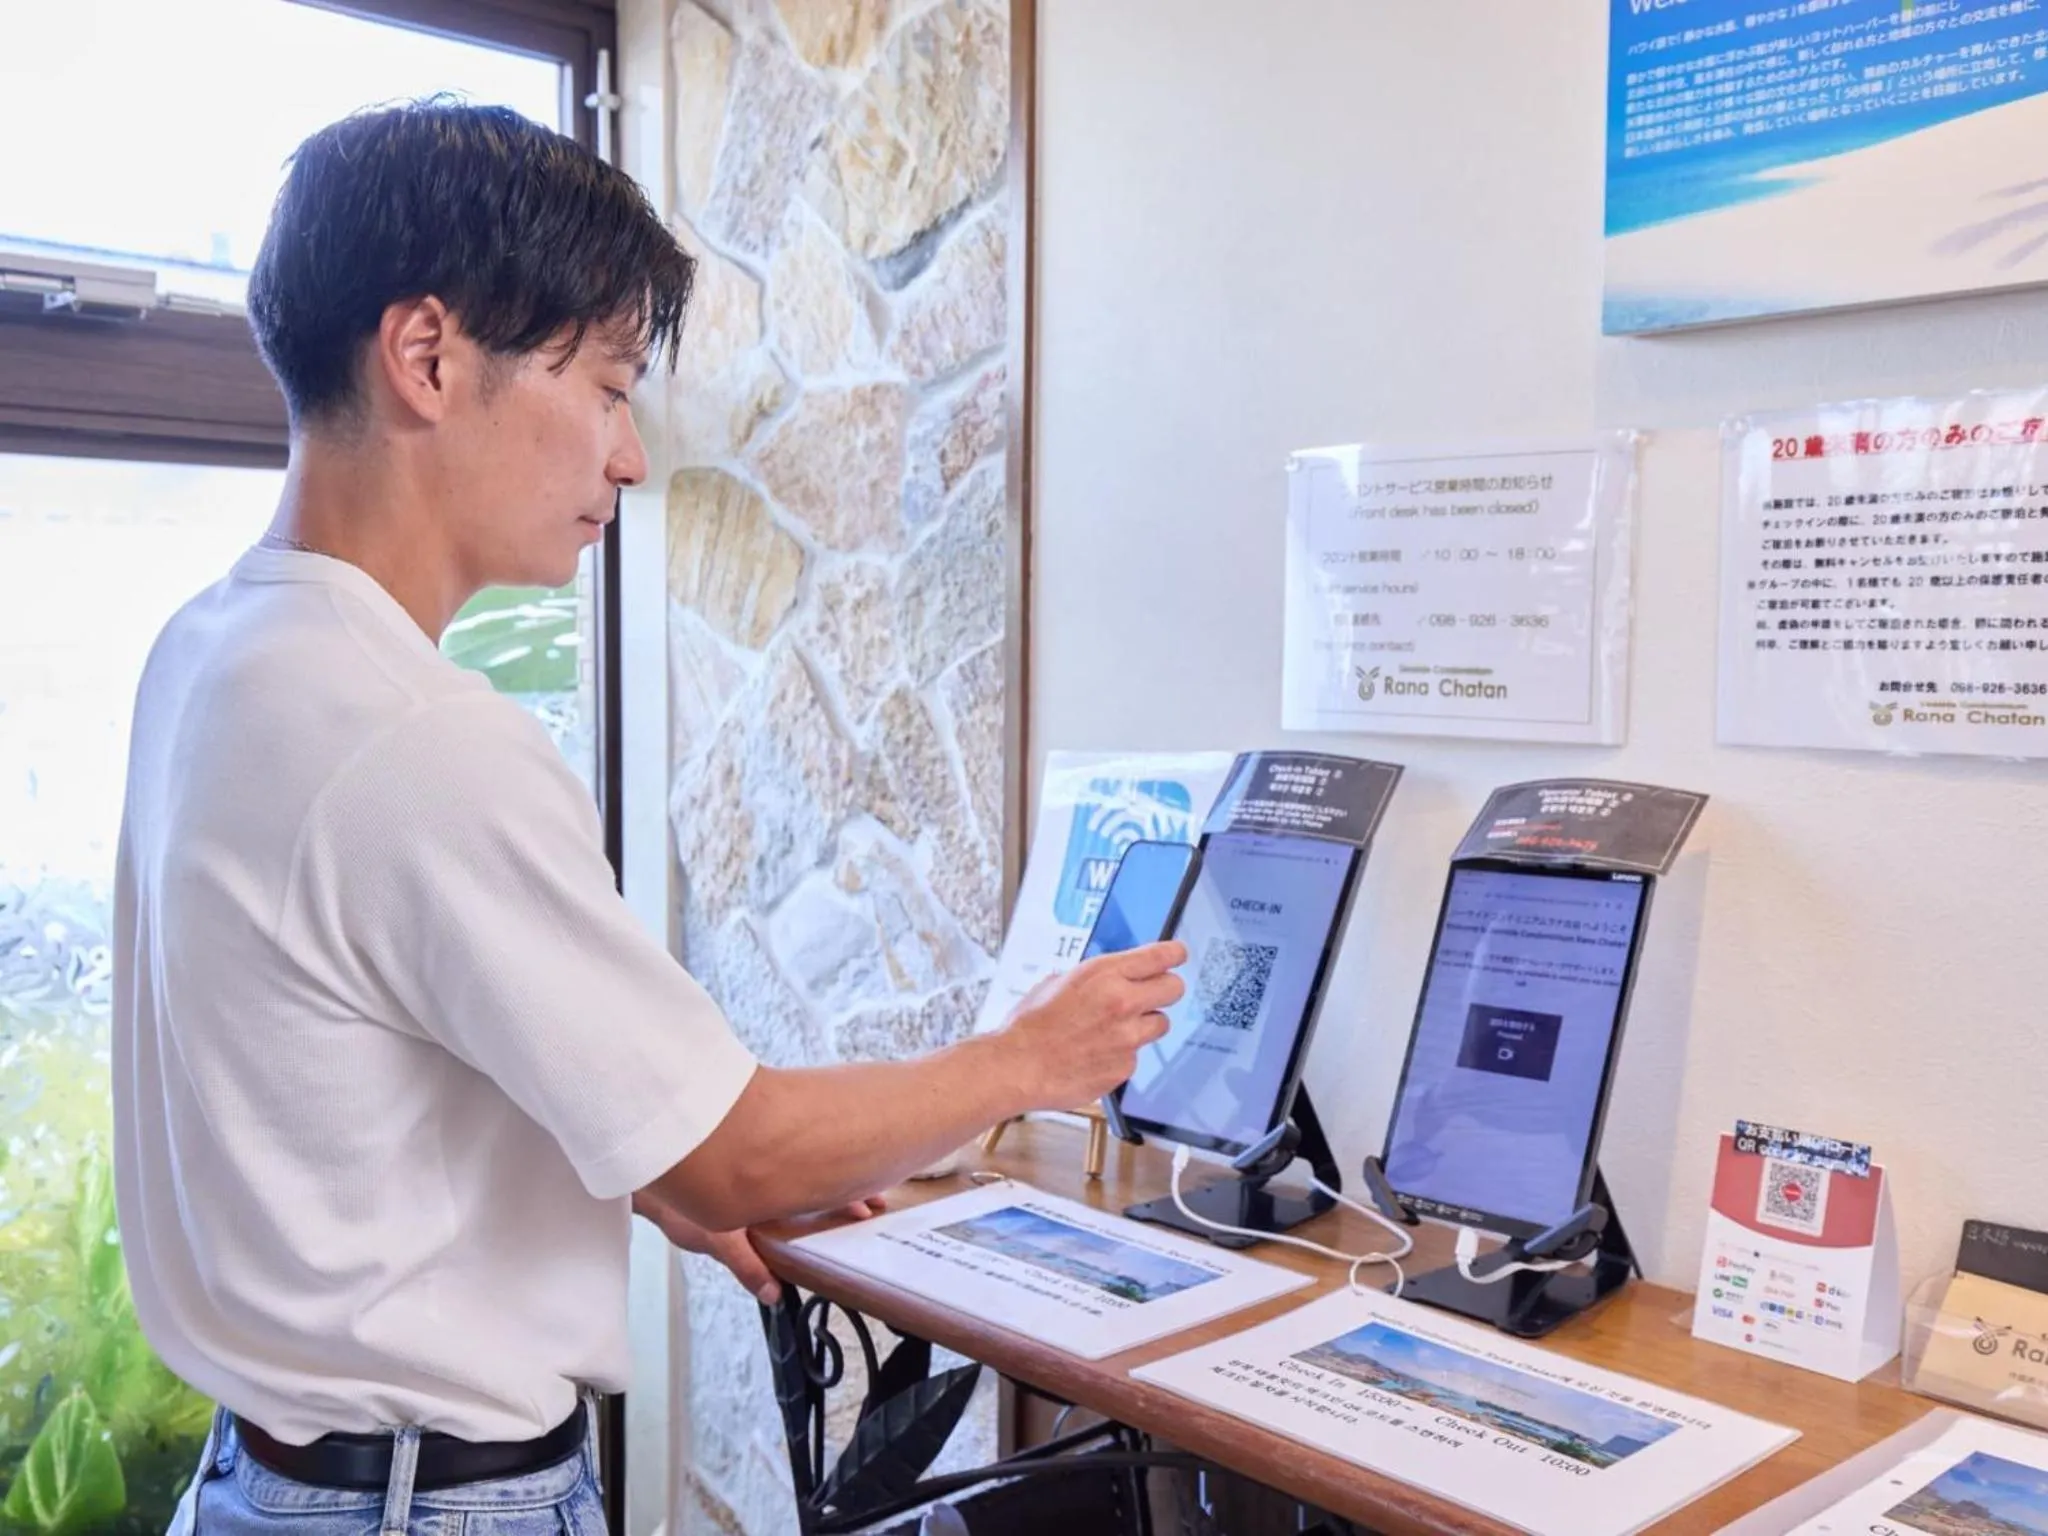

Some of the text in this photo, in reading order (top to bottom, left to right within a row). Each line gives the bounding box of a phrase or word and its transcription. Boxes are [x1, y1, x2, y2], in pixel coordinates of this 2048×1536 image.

[1385, 676, 1508, 699] Rana Chatan
[1902, 708, 2046, 727] Rana Chatan
[1230, 896, 1283, 916] CHECK-IN
[1737, 1137, 1756, 1153] QR
[1712, 1305, 1734, 1319] VISA
[1278, 1359, 1325, 1382] Check
[1434, 1414, 1489, 1440] Check
[1492, 1435, 1529, 1455] Out
[1539, 1452, 1592, 1478] 10:00
